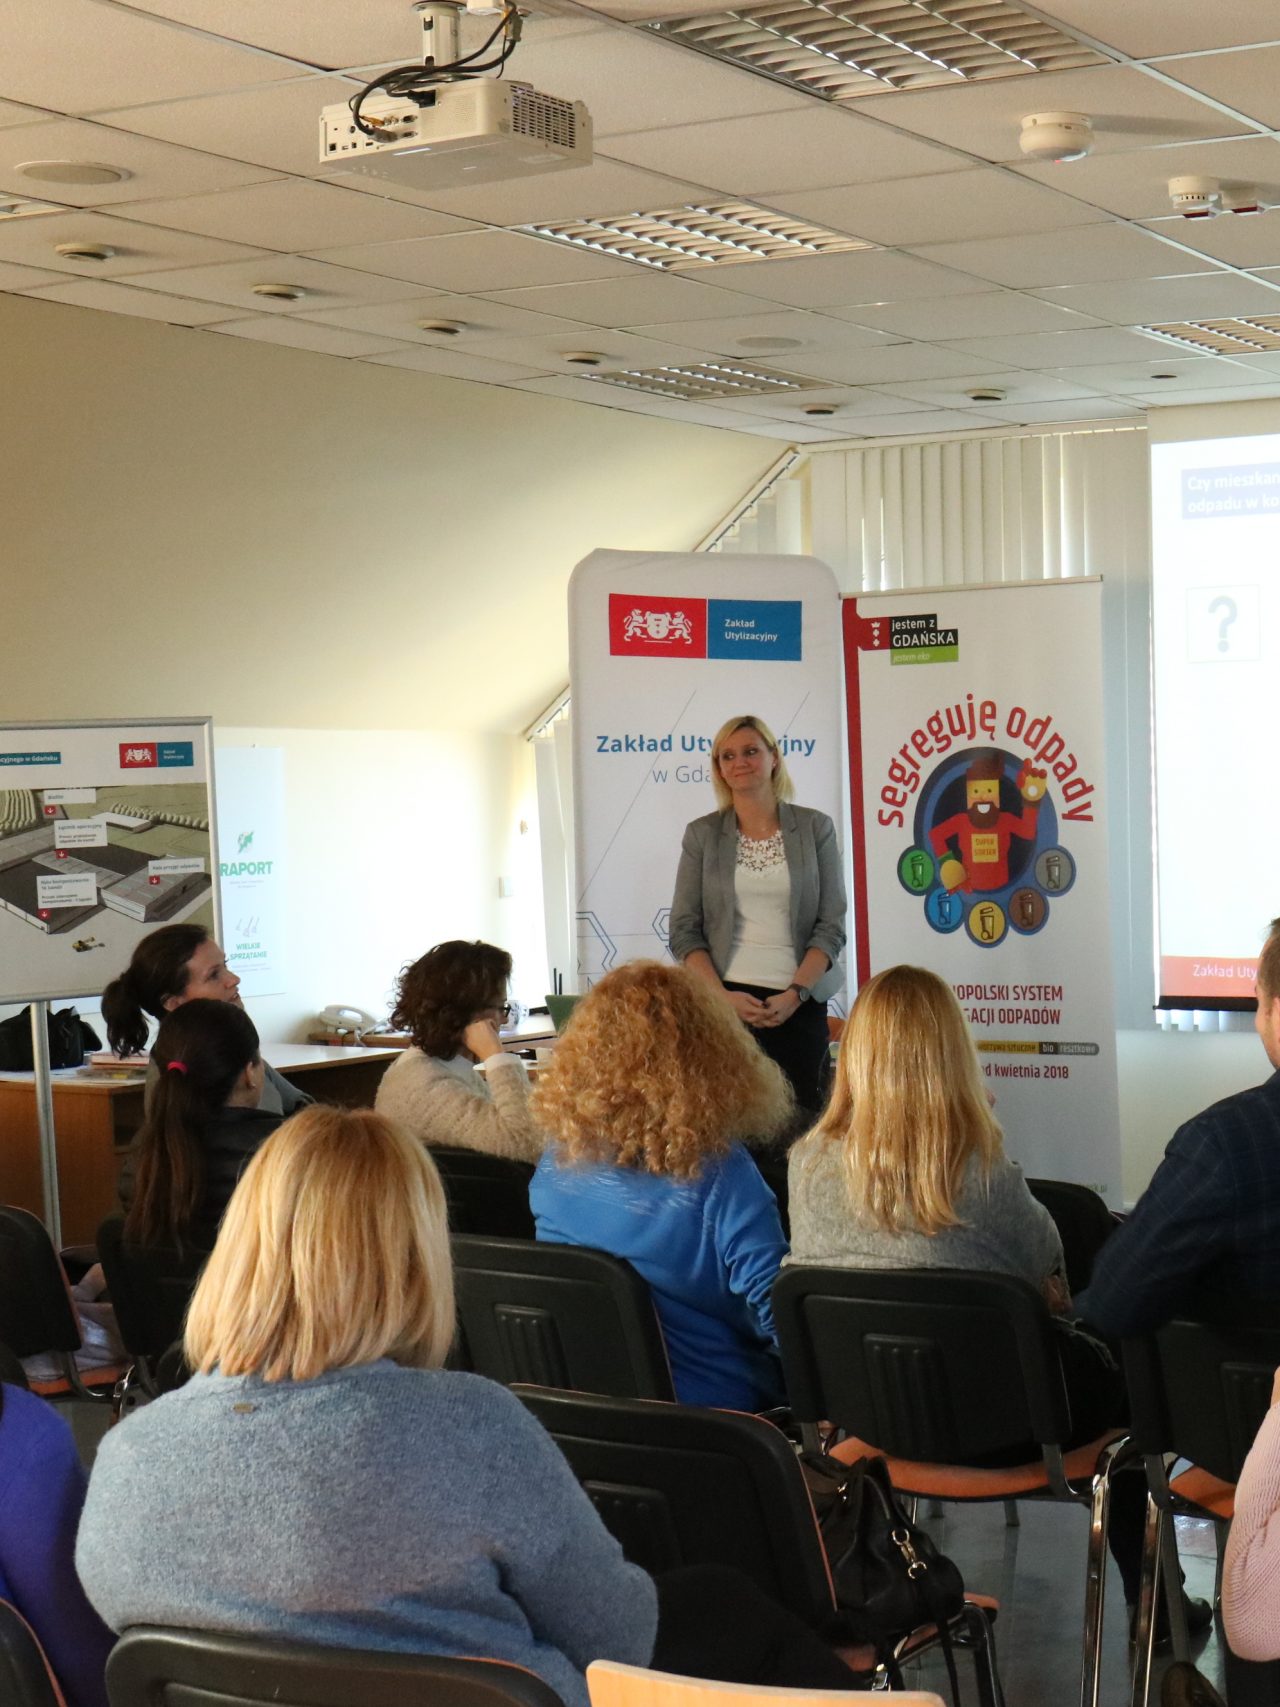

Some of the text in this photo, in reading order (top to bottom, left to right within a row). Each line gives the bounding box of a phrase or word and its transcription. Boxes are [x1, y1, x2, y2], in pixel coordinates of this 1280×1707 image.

[1188, 475, 1211, 493] Czy
[1188, 496, 1242, 515] odpadu
[1245, 498, 1259, 510] w
[725, 618, 755, 629] Zakład
[891, 619, 935, 632] jestem z
[725, 631, 778, 642] Utylizacyjny
[892, 630, 955, 648] GDAŃSKA
[596, 735, 673, 753] Zakład
[878, 693, 1095, 828] segreguję odpady
[653, 769, 668, 783] w
[219, 861, 273, 877] RAPORT
[1193, 963, 1234, 977] Zakład
[1013, 985, 1063, 1002] SYSTEM
[998, 1005, 1061, 1025] ODPADÓW
[1042, 1042, 1054, 1052] bio
[995, 1063, 1041, 1078] kwietnia
[1043, 1065, 1069, 1079] 2018
